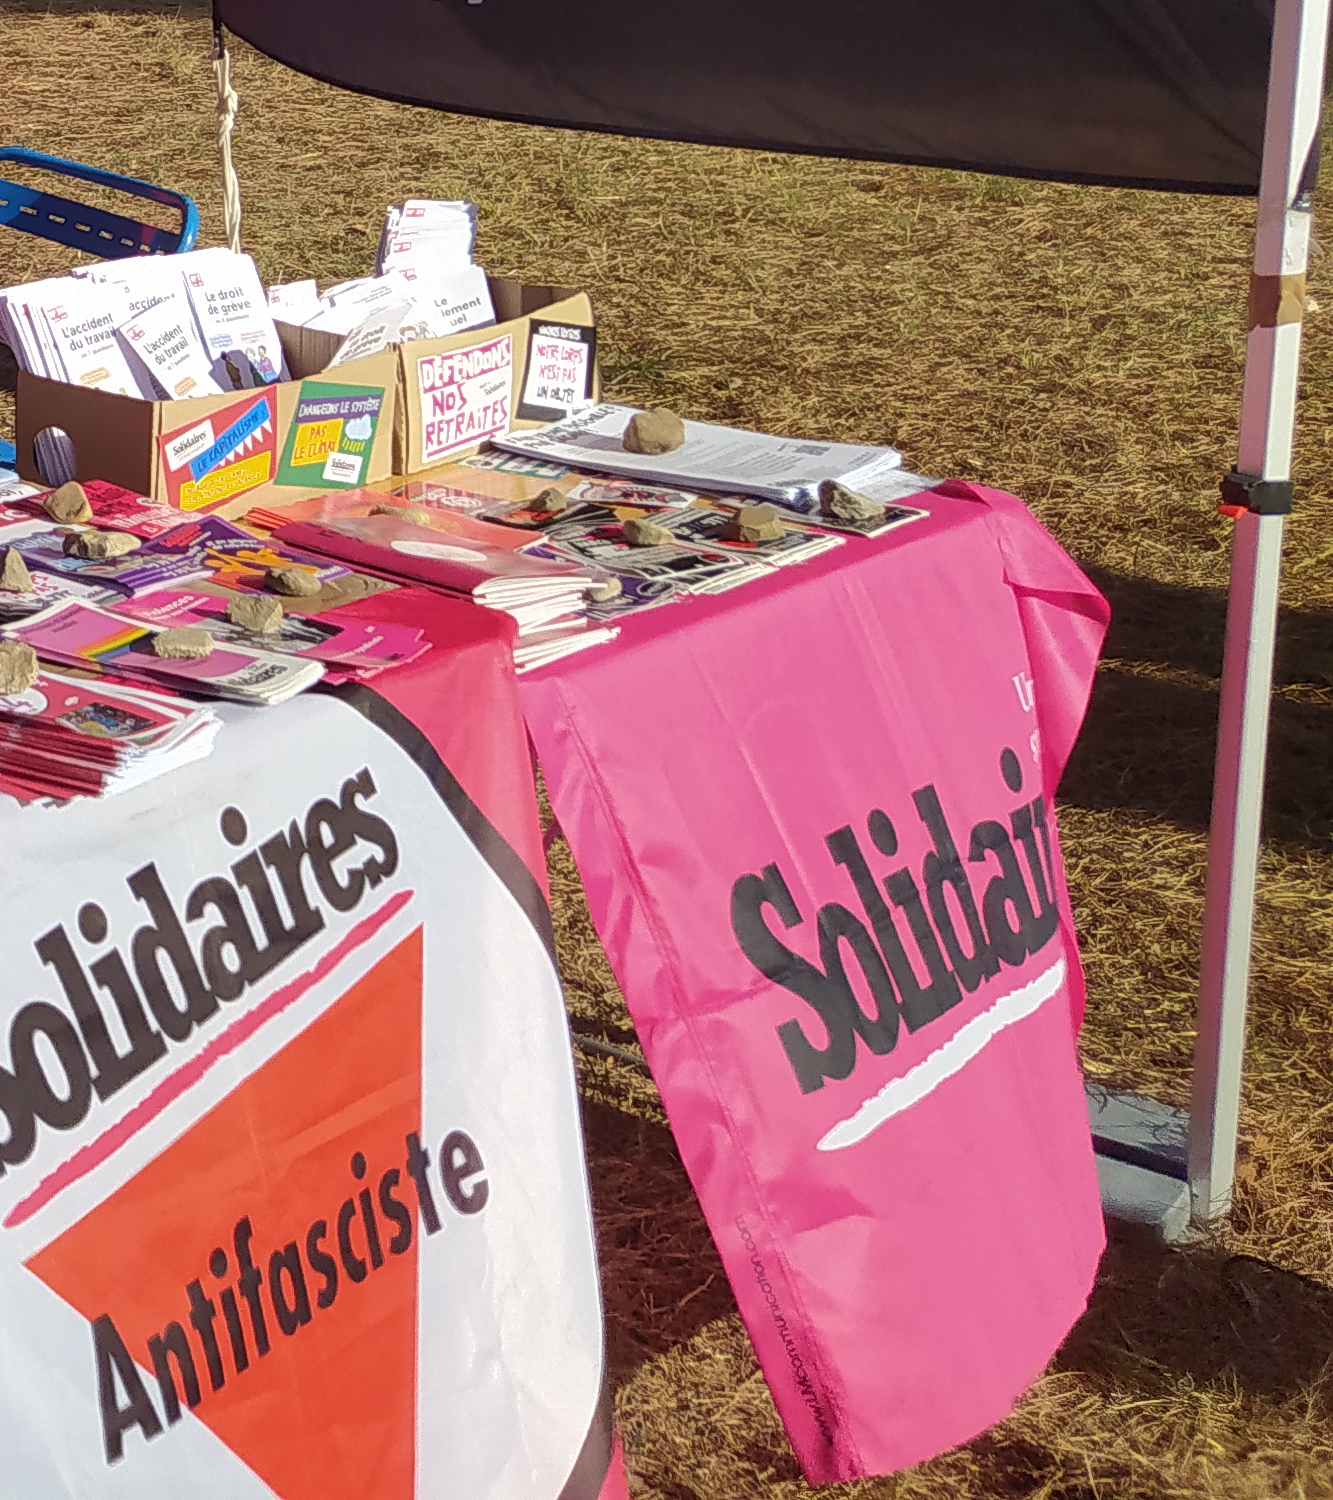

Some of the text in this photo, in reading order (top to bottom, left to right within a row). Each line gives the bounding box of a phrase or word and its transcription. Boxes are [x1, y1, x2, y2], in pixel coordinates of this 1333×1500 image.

[205, 288, 244, 302] Le droit
[434, 297, 448, 308] Le
[208, 301, 251, 315] de grève
[61, 313, 114, 339] L'accident
[70, 327, 118, 352] du travail
[143, 324, 183, 355] L'accident
[154, 352, 167, 366] du
[166, 337, 189, 360] travail
[421, 335, 511, 389] DÉFENDONS
[340, 400, 350, 414] LE
[432, 382, 468, 417] NOS
[310, 426, 327, 439] PAS
[91, 1125, 491, 1468] Antifasciste
